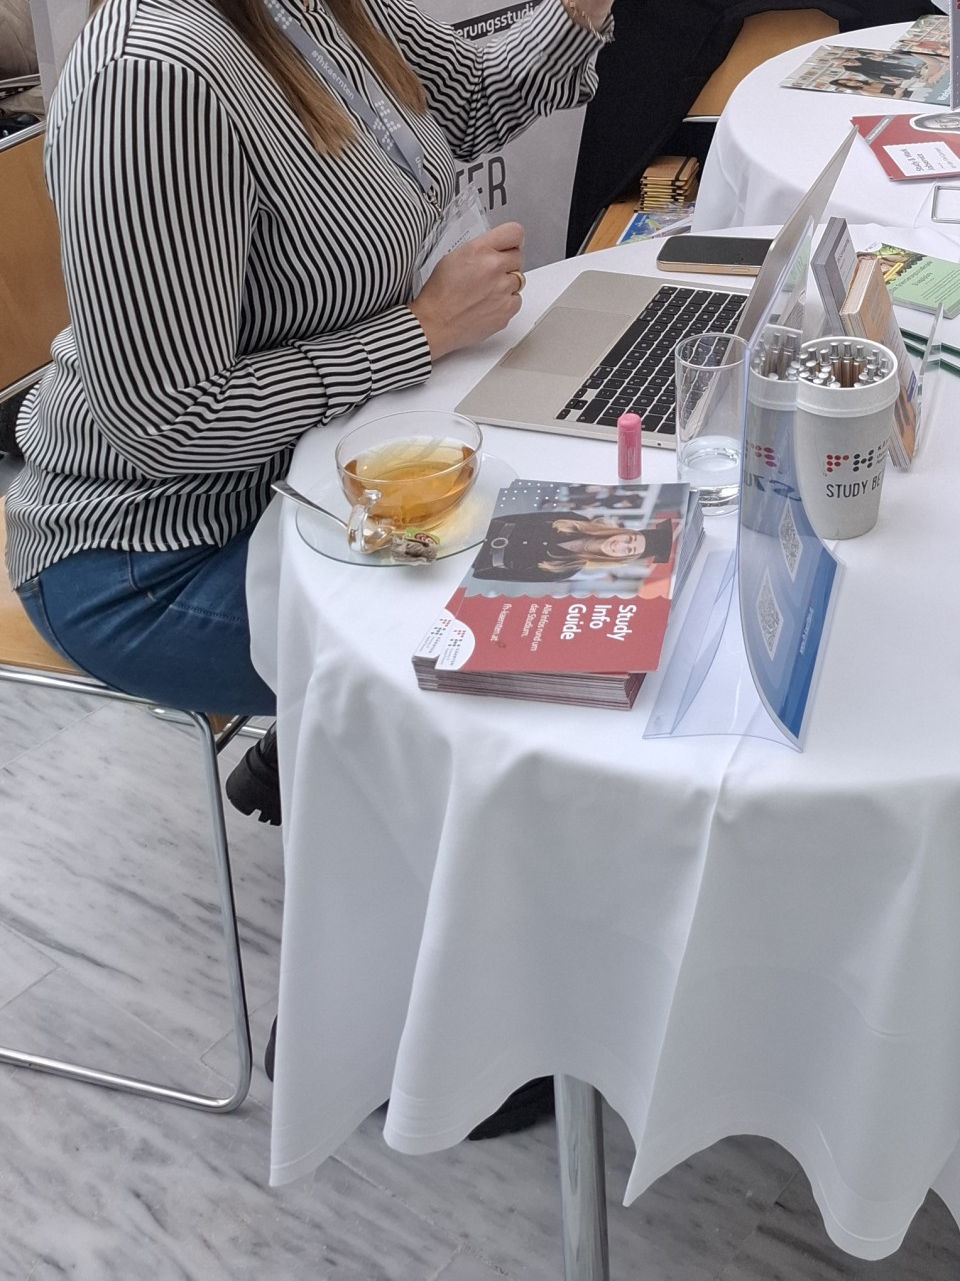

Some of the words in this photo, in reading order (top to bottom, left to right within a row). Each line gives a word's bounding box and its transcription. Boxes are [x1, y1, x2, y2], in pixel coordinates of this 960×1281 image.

[826, 480, 868, 498] STUDY
[528, 603, 539, 613] das
[541, 603, 553, 614] Alle
[561, 604, 587, 640] Guide
[590, 604, 613, 630] Info
[608, 604, 637, 641] Study
[533, 628, 545, 641] rund
[529, 641, 540, 652] um
